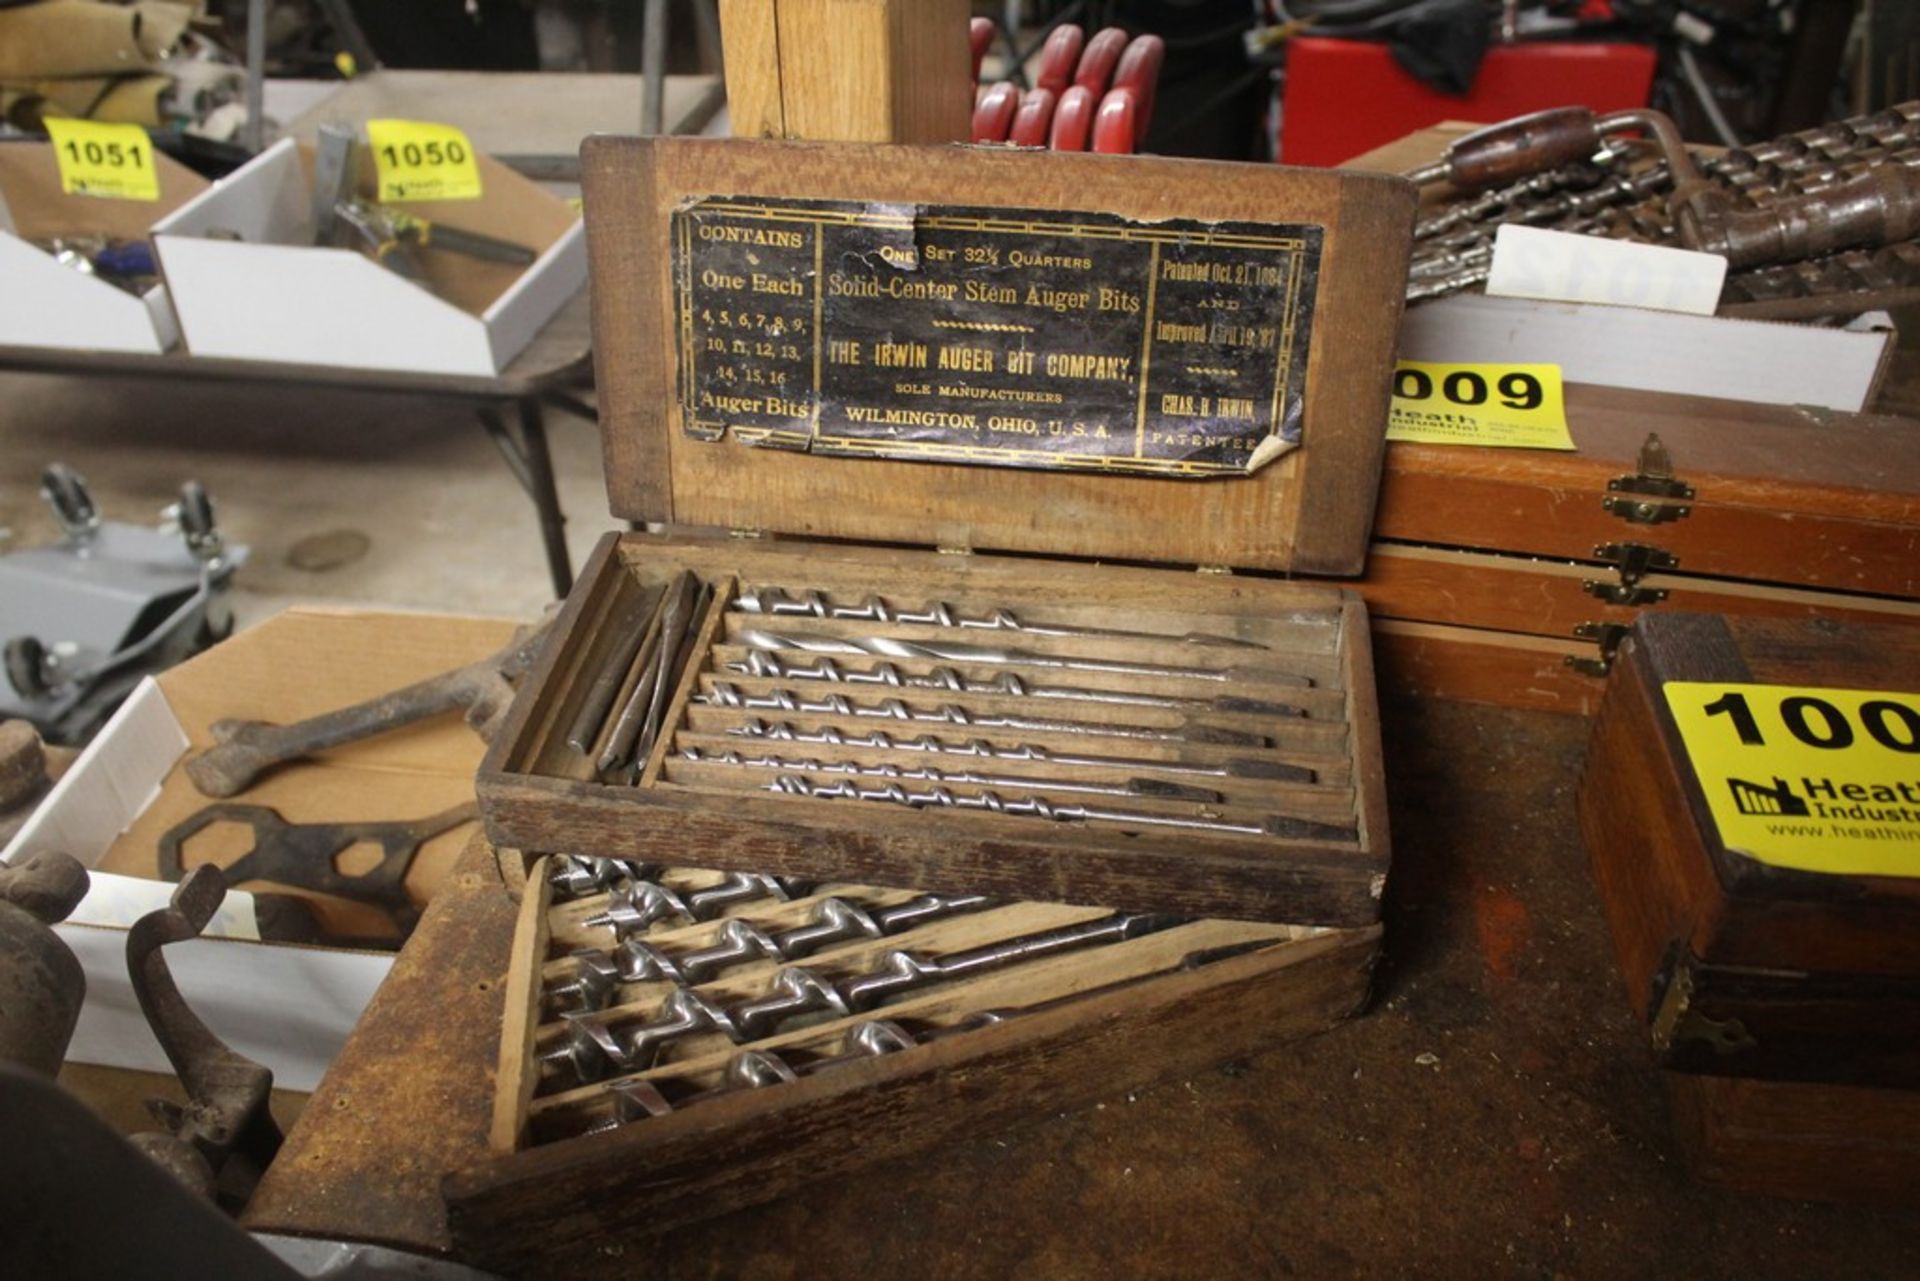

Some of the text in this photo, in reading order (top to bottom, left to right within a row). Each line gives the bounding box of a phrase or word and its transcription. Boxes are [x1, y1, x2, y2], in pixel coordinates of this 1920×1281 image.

[64, 141, 142, 169] 1051
[382, 141, 465, 168] 1050
[699, 224, 803, 249] CONTAINS
[702, 269, 803, 296] One Each
[1162, 260, 1210, 281] Patented
[1212, 262, 1233, 284] Oct.
[828, 272, 1141, 315] Solid-Center Stem Auger Bits
[1197, 299, 1241, 311] AND
[702, 309, 715, 325] 4,
[720, 310, 732, 327] 5,
[738, 312, 752, 330] 6,
[793, 318, 806, 335] 9,
[707, 338, 727, 353] 10,
[756, 342, 776, 359] 12,
[781, 345, 801, 361] 13,
[828, 340, 1134, 383] THE IRWIN AUGER BIT COMPANY,
[702, 391, 809, 419] Auger Bits
[895, 383, 1063, 404] SOLE MANUFACTURERS
[1162, 394, 1199, 416] CHAS.
[845, 406, 980, 432] WILMINGTON,
[987, 416, 1040, 437] OHIO,
[1801, 777, 1920, 804] Heat
